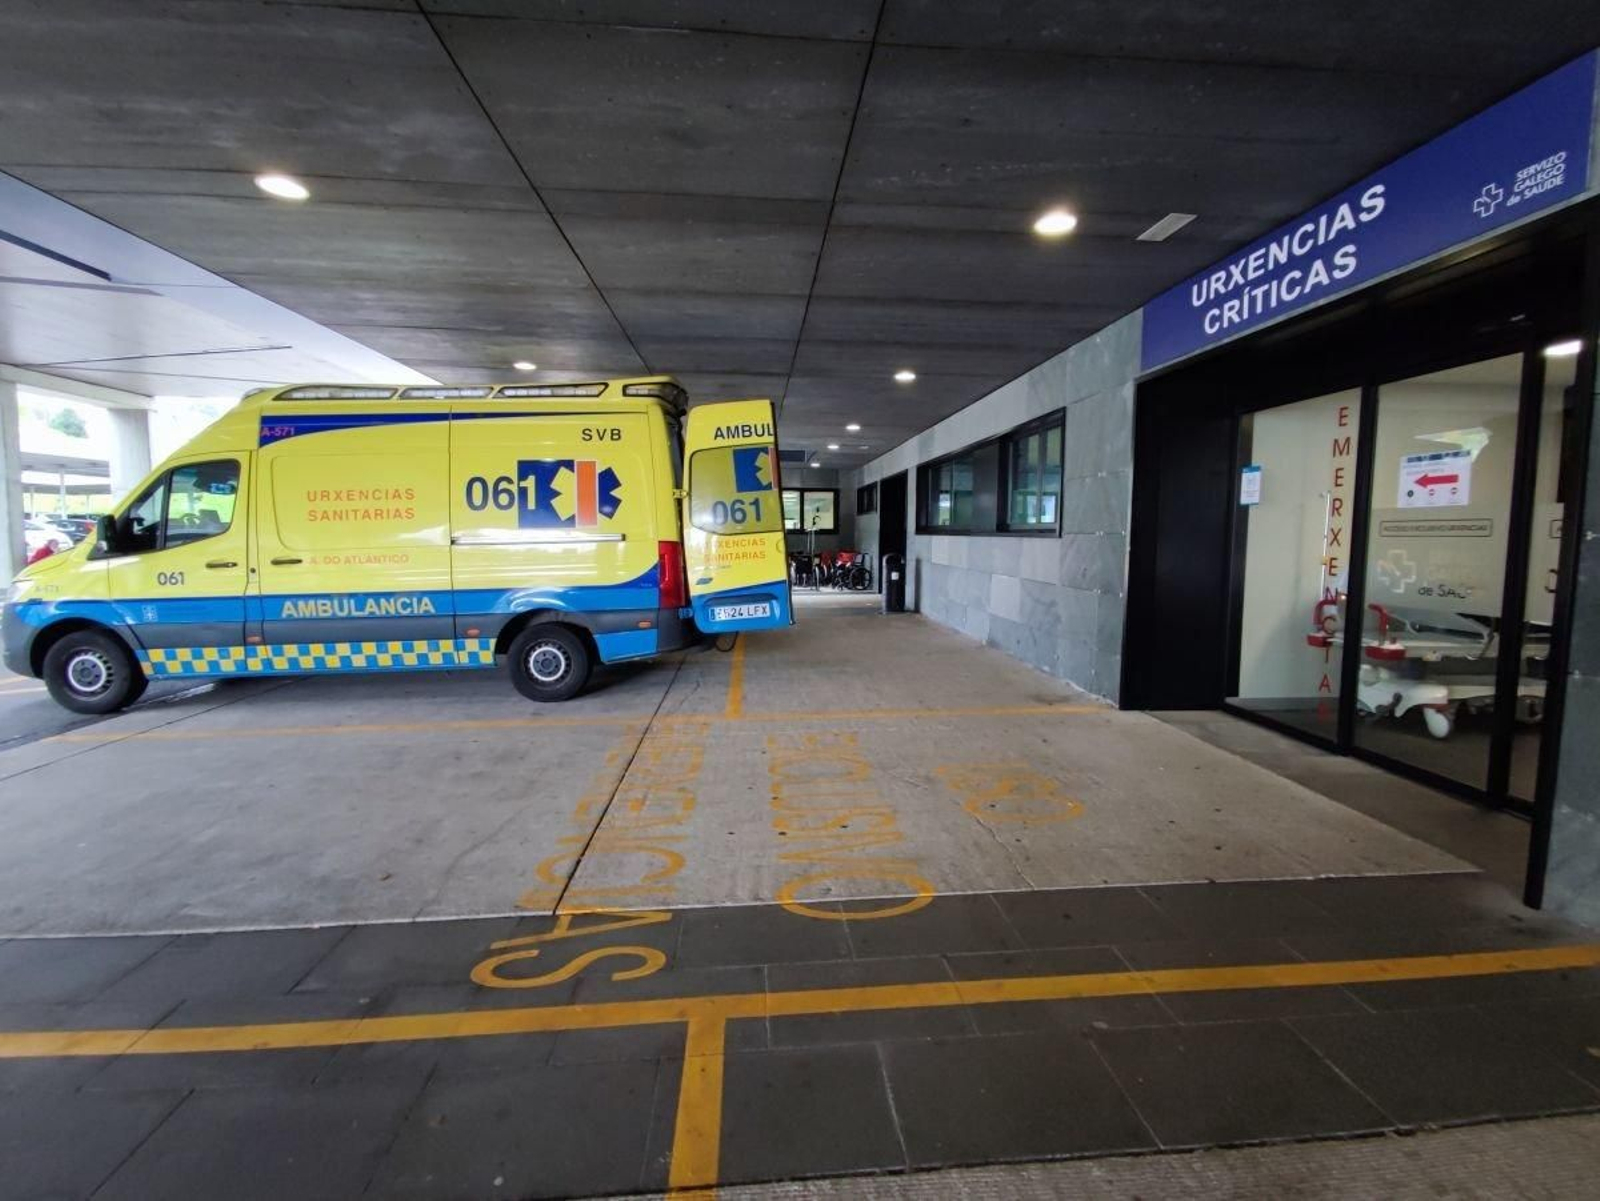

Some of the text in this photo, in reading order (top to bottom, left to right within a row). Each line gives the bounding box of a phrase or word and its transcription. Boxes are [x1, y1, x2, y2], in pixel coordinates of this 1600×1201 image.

[1514, 151, 1567, 181] SERVIZO
[1513, 163, 1565, 192] GALEGO
[1191, 184, 1386, 307] URXENCIAS
[1204, 244, 1358, 334] CRÍTICAS
[260, 426, 295, 437] A-571
[581, 428, 623, 441] SVB
[713, 423, 774, 440] AMBUL
[306, 488, 416, 503] URXENCIAS
[465, 475, 537, 511] 061
[307, 507, 416, 522] SANITARIAS
[713, 498, 762, 525] 061
[323, 555, 341, 565] DO
[157, 571, 185, 586] 061
[281, 596, 435, 619] AMBULANCIA
